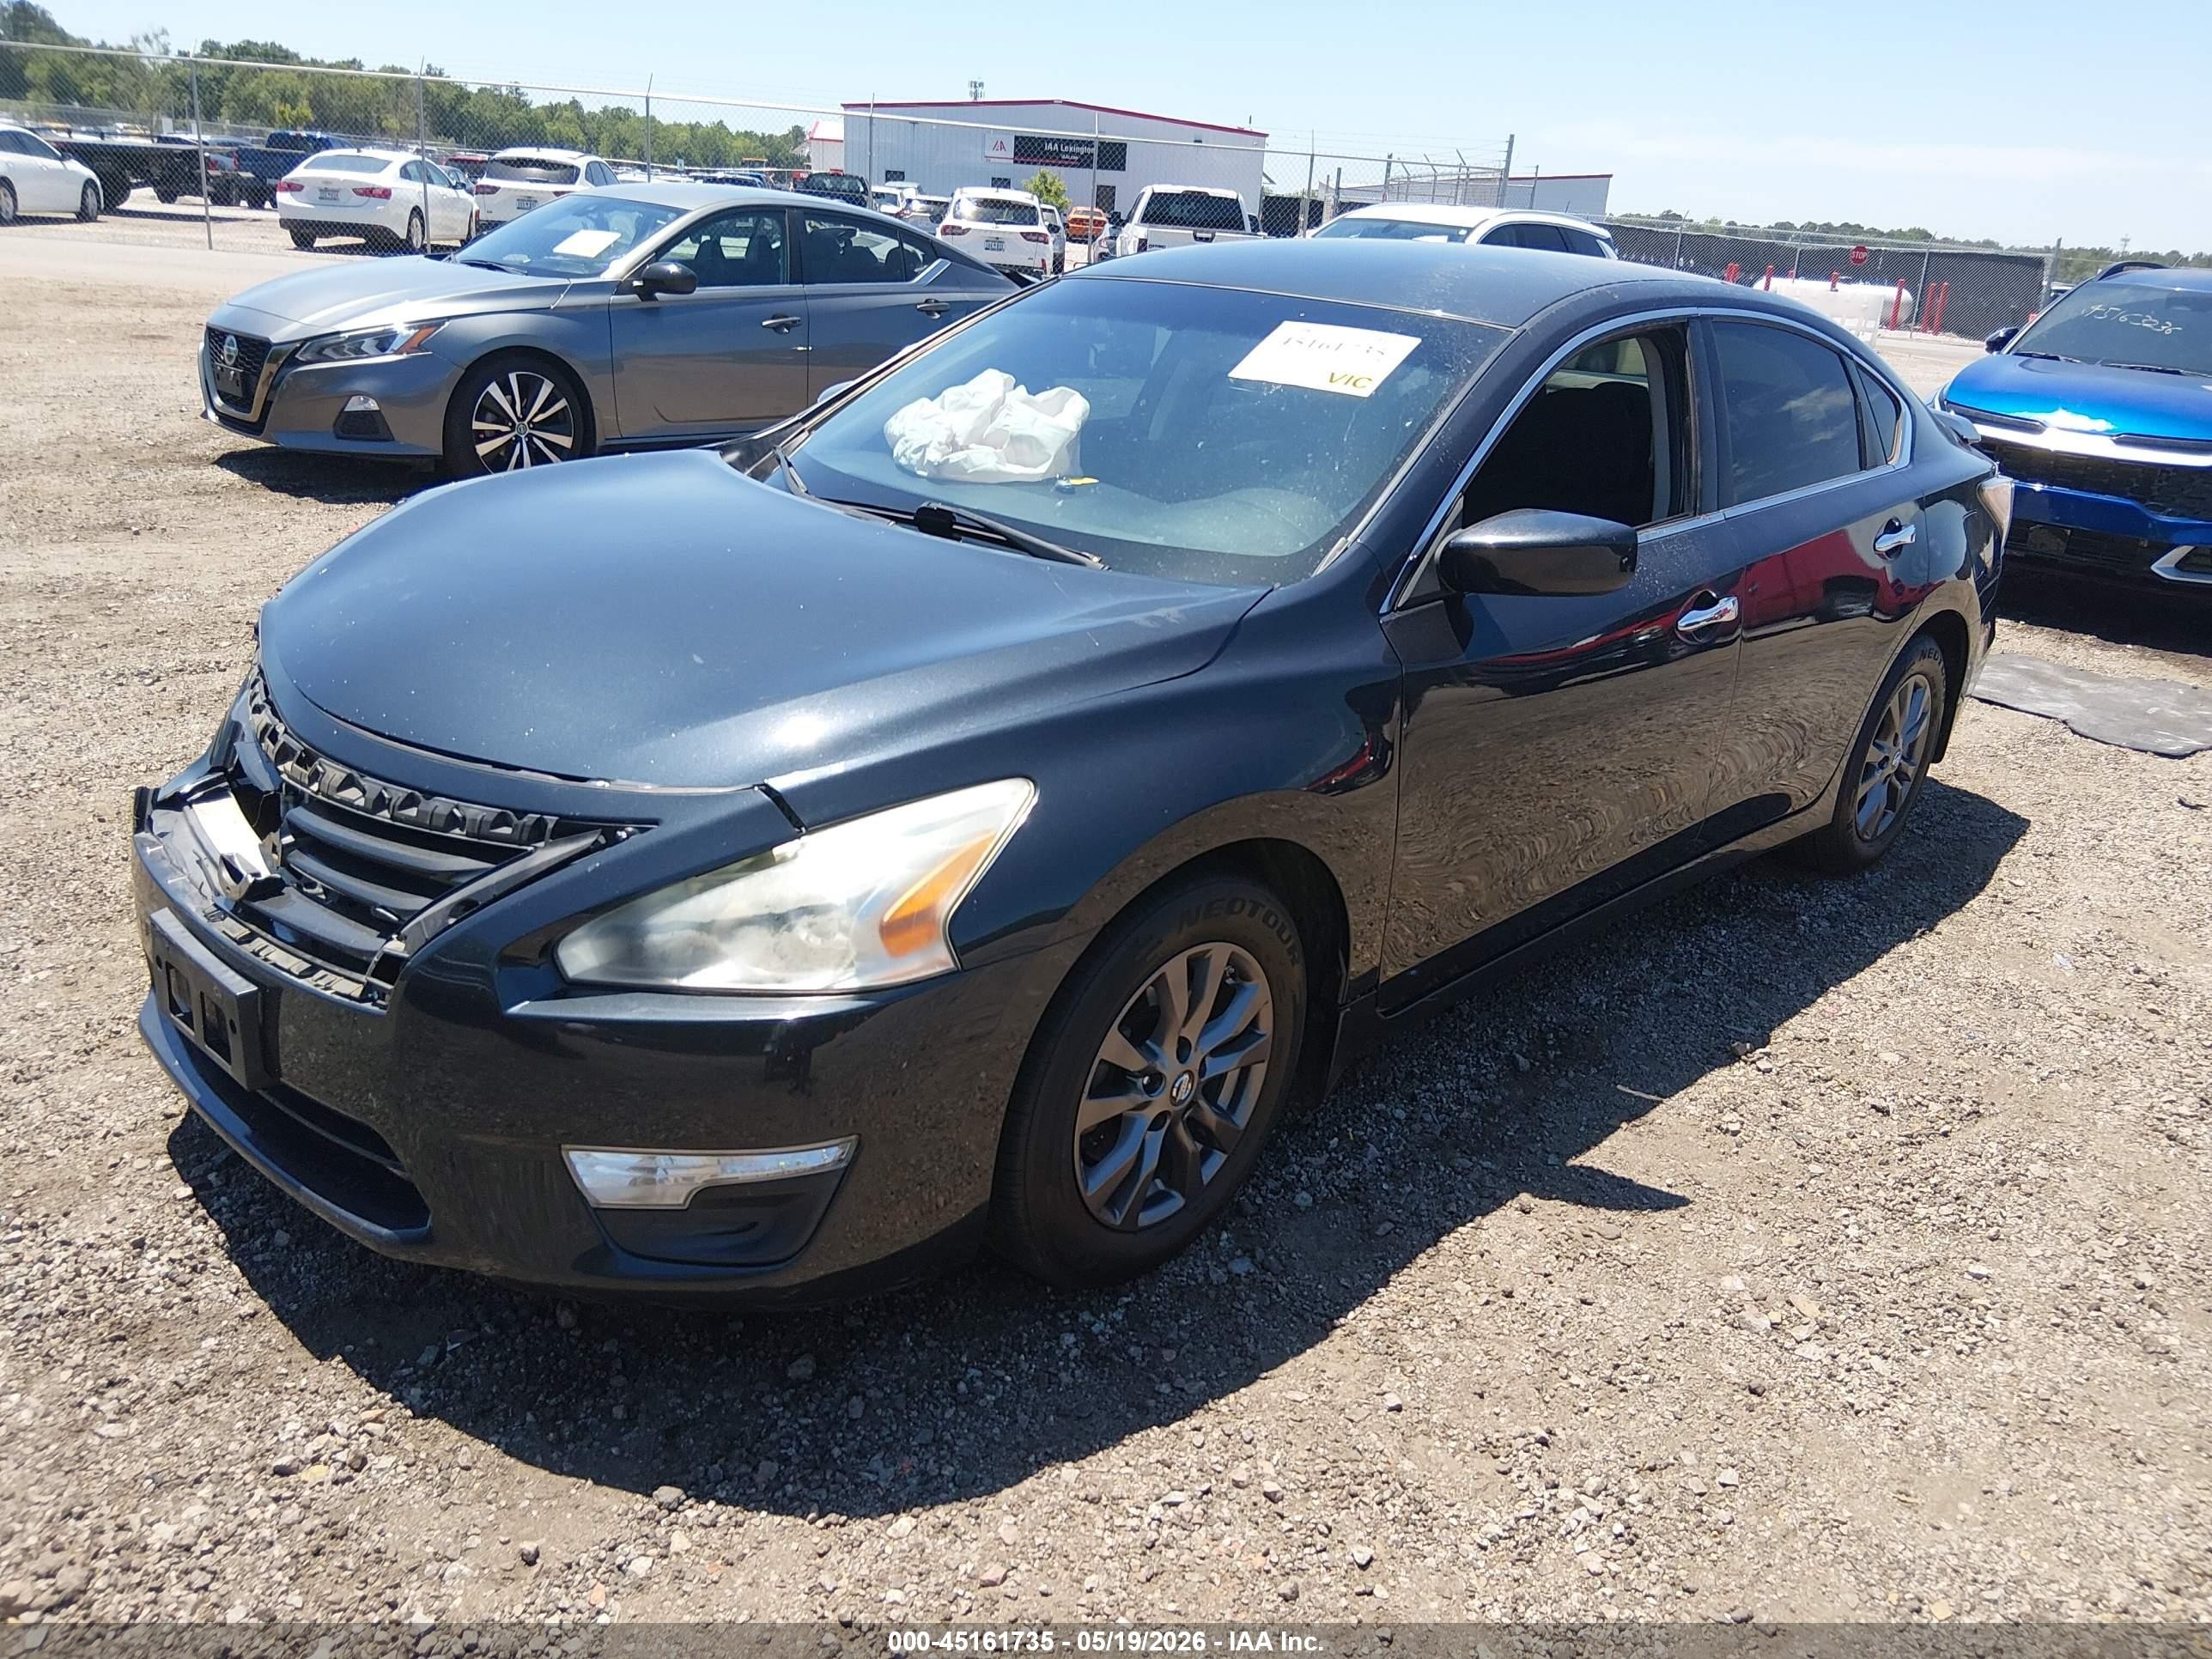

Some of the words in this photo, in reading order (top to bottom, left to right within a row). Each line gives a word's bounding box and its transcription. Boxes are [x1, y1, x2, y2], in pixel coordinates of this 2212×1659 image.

[1044, 142, 1059, 152] IAA
[1851, 251, 1868, 259] STOP
[1328, 372, 1373, 389] VIC
[1178, 896, 1299, 967] NEOTOUR
